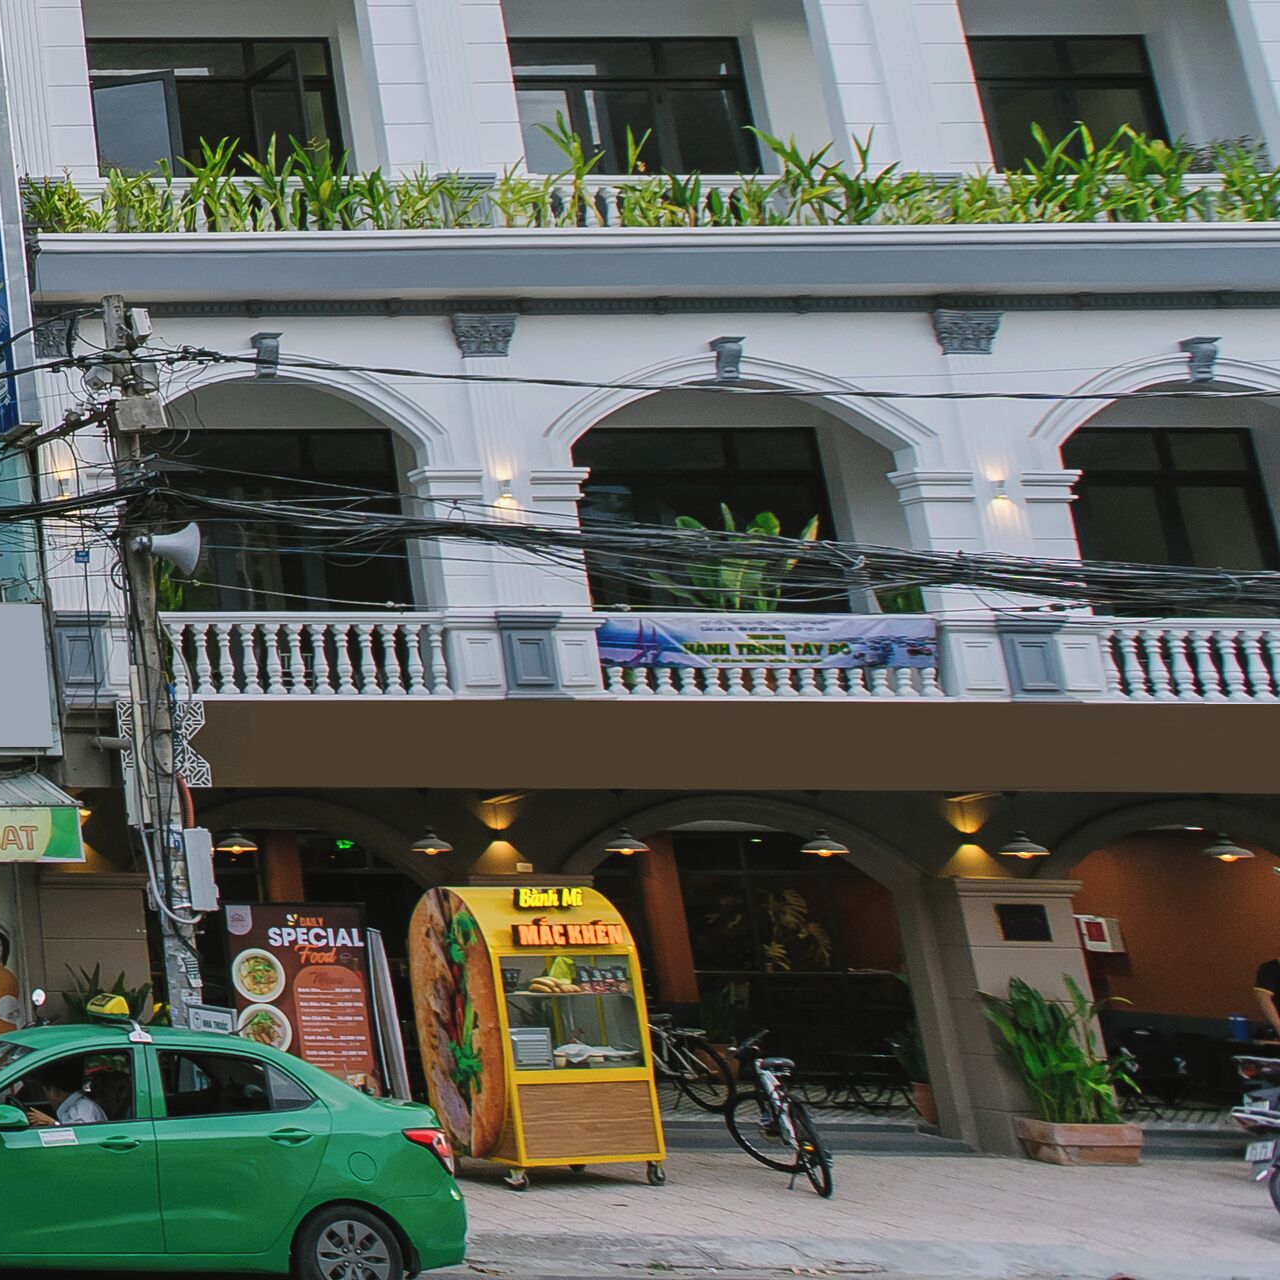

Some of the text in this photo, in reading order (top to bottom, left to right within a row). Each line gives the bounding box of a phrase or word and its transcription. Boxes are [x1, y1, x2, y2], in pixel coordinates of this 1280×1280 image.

[791, 641, 824, 656] TÂY
[299, 916, 325, 927] DAILY
[268, 927, 365, 947] SPECIAL
[294, 943, 337, 965] Food
